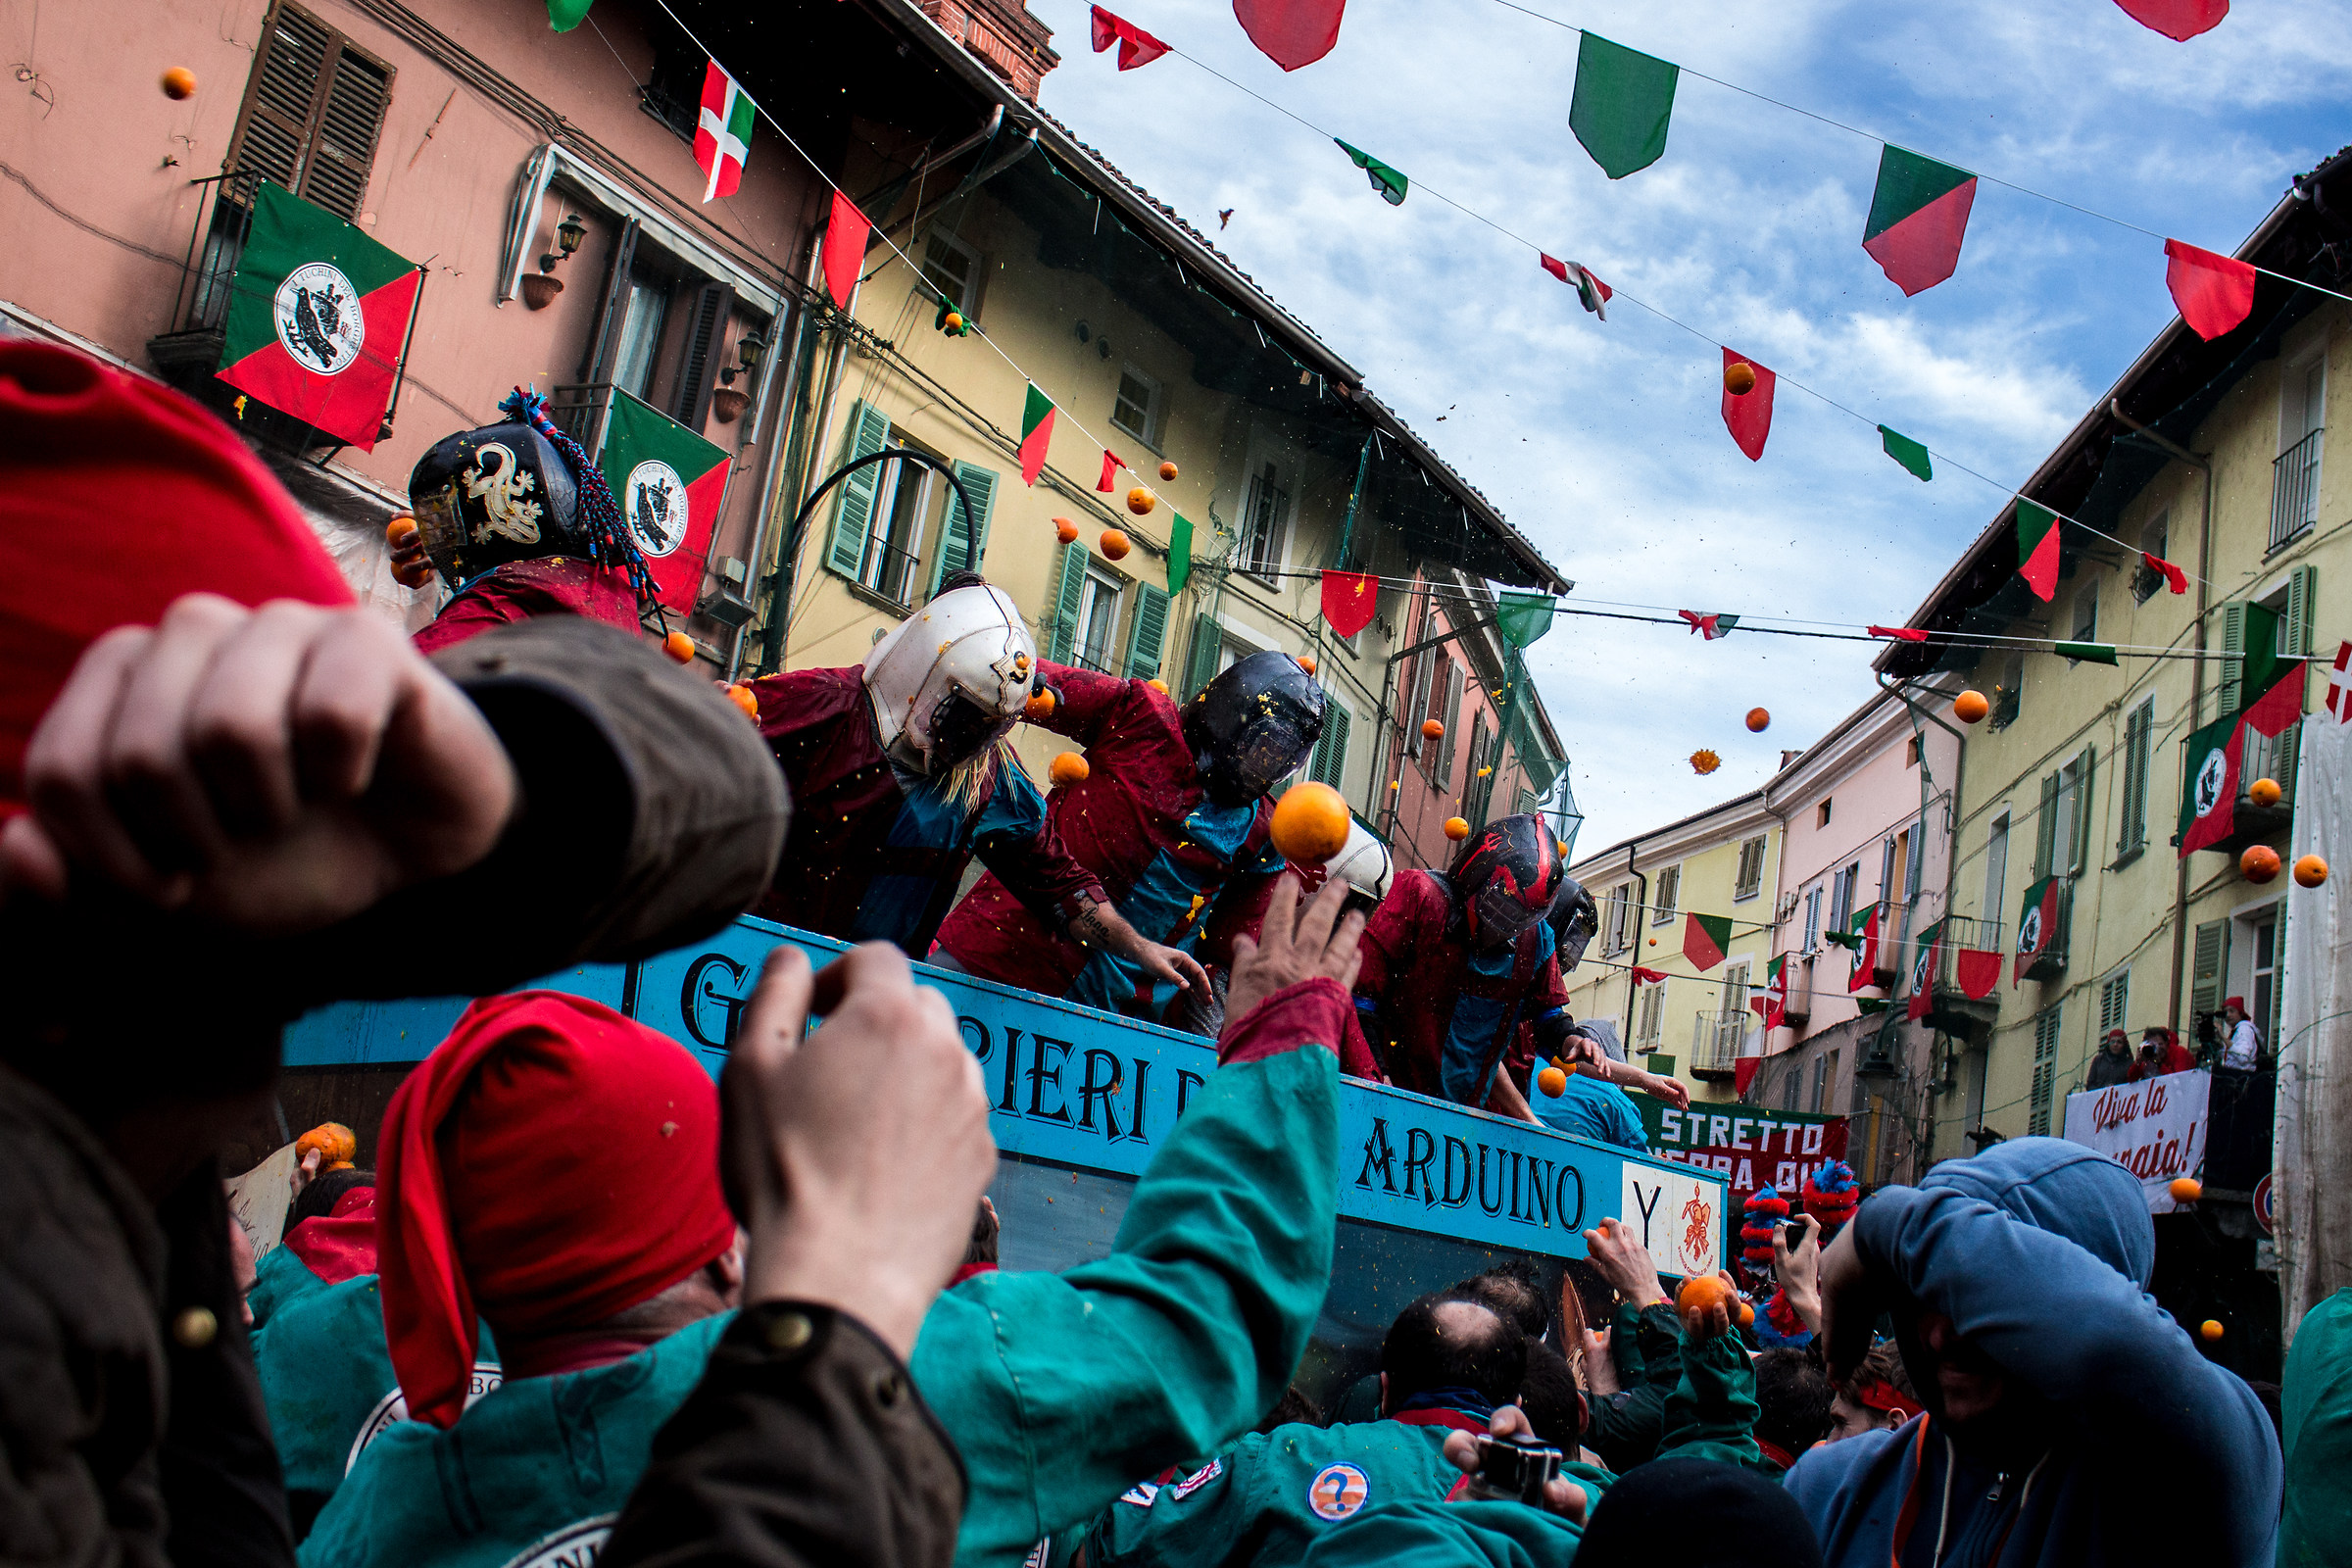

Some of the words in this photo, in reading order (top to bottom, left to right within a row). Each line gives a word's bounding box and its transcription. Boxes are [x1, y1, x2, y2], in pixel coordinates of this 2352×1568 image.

[299, 268, 337, 281] TUCHINI
[338, 279, 351, 301] DEL
[334, 305, 362, 367] BORGHETTO
[1661, 1107, 1825, 1155] STRETTO
[2093, 1087, 2140, 1134] Viva
[2143, 1078, 2168, 1118] la
[1354, 1116, 1587, 1235] ARDUINO
[1633, 1180, 1662, 1250] Y
